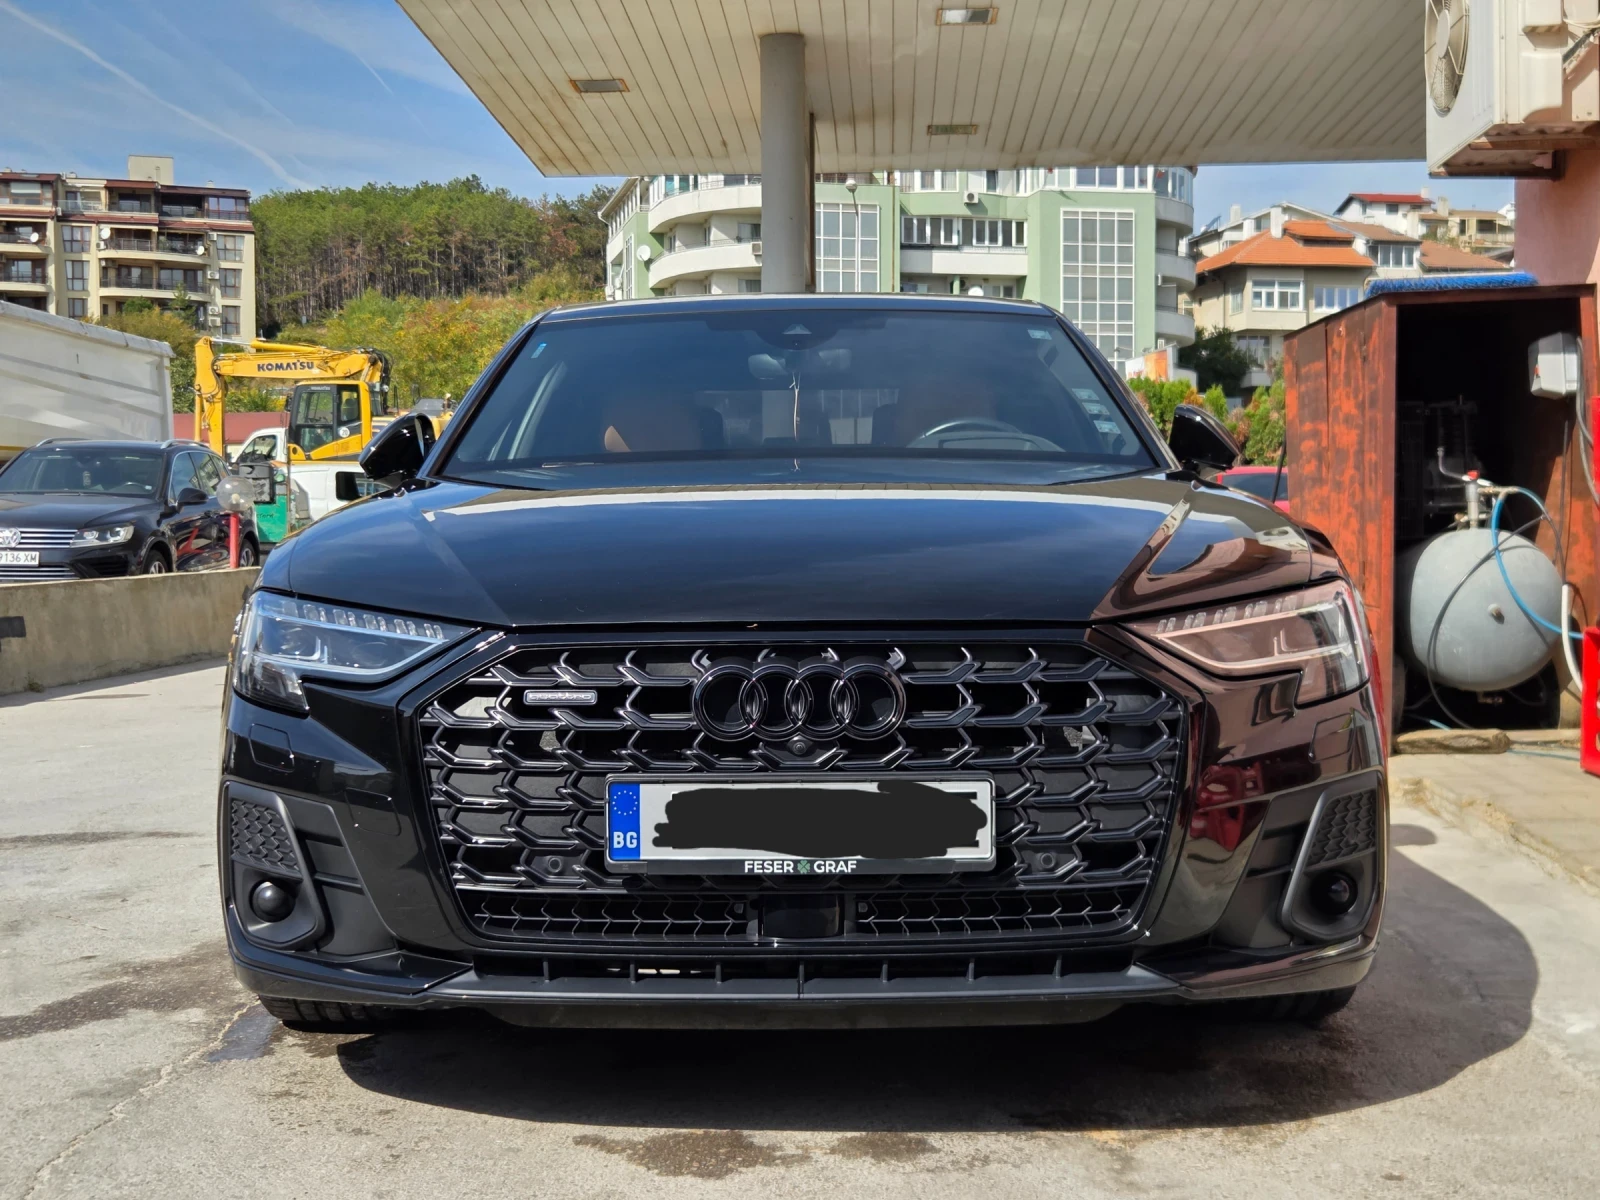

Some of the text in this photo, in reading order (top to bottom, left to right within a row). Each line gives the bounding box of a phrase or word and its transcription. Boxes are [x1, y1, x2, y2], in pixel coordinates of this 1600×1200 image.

[257, 360, 314, 372] KOMATSU
[24, 553, 37, 562] XM
[613, 831, 638, 849] BG
[744, 860, 857, 873] FESER GRAF
